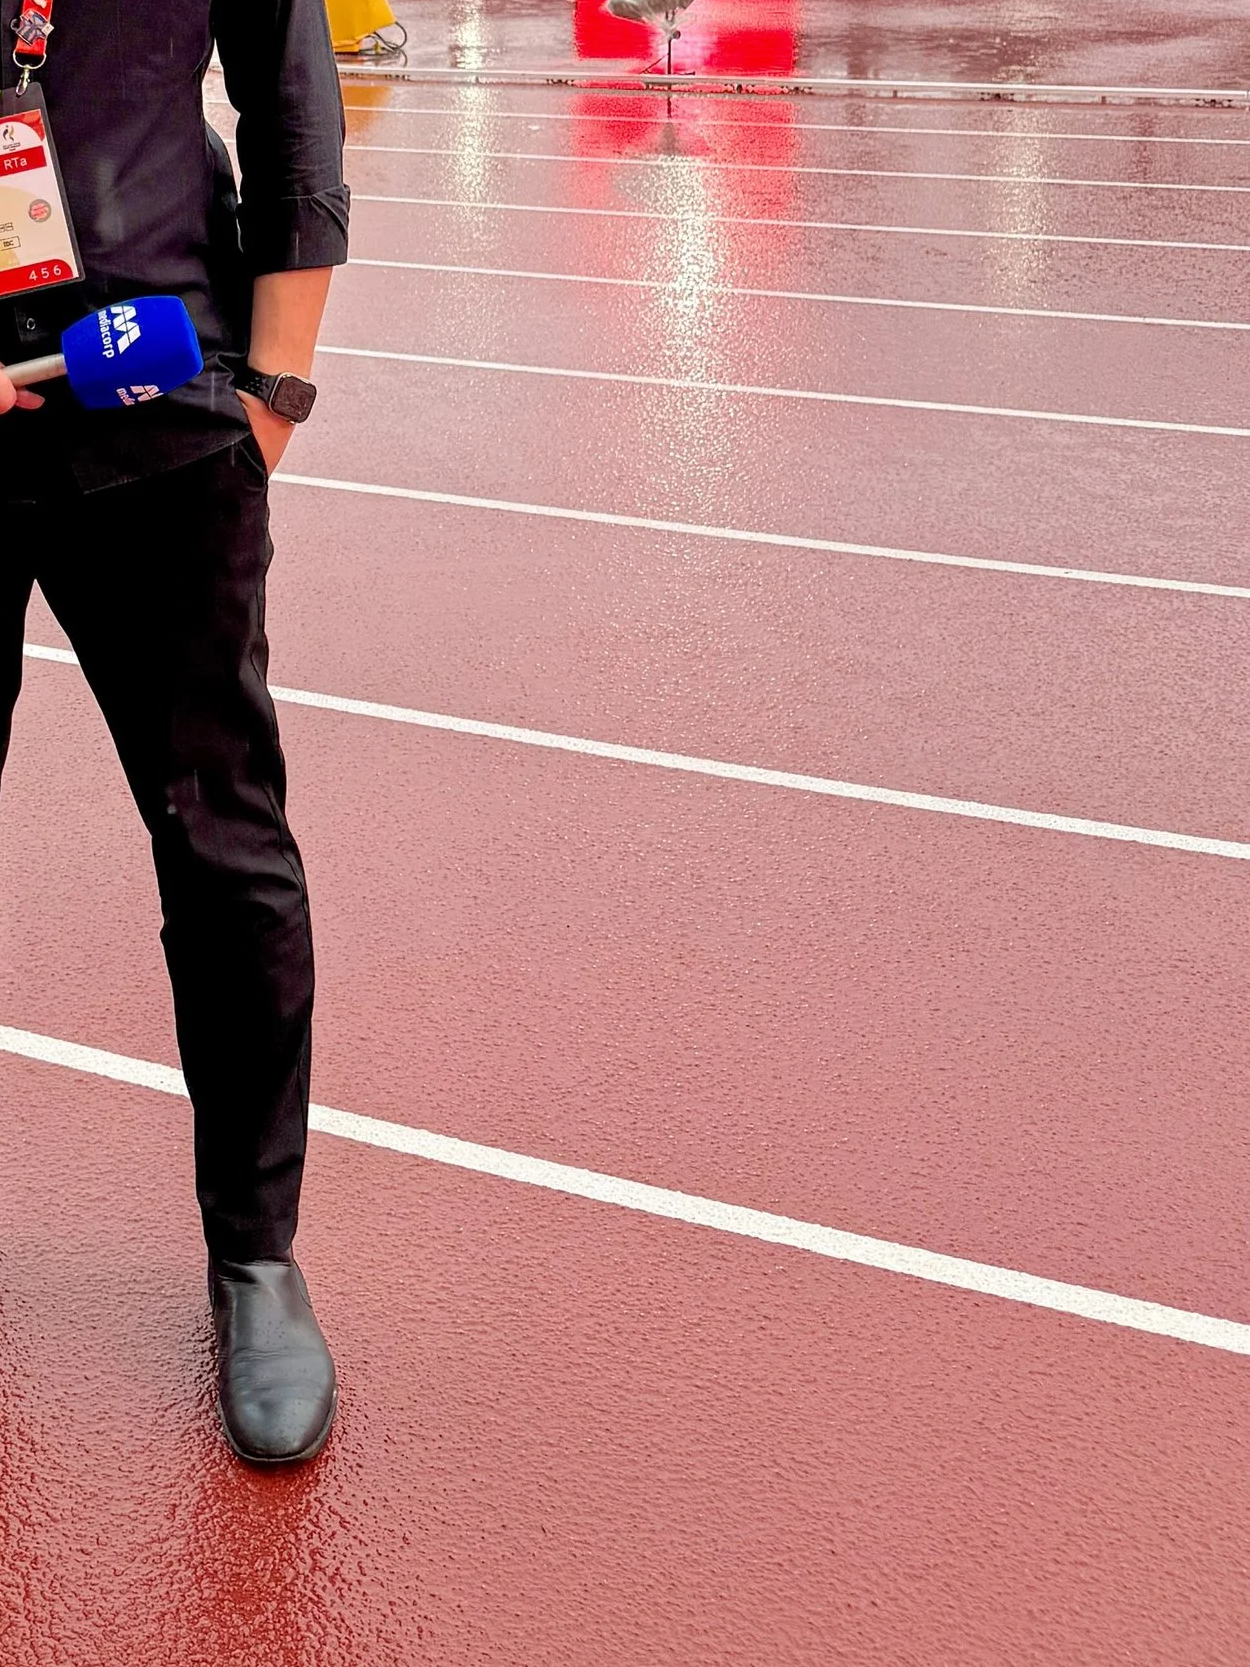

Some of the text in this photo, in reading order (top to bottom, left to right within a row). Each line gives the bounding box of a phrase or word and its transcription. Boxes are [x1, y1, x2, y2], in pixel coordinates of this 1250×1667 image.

[3, 157, 28, 171] RTa
[29, 264, 62, 281] 4 5 6
[97, 309, 115, 359] mediacorp
